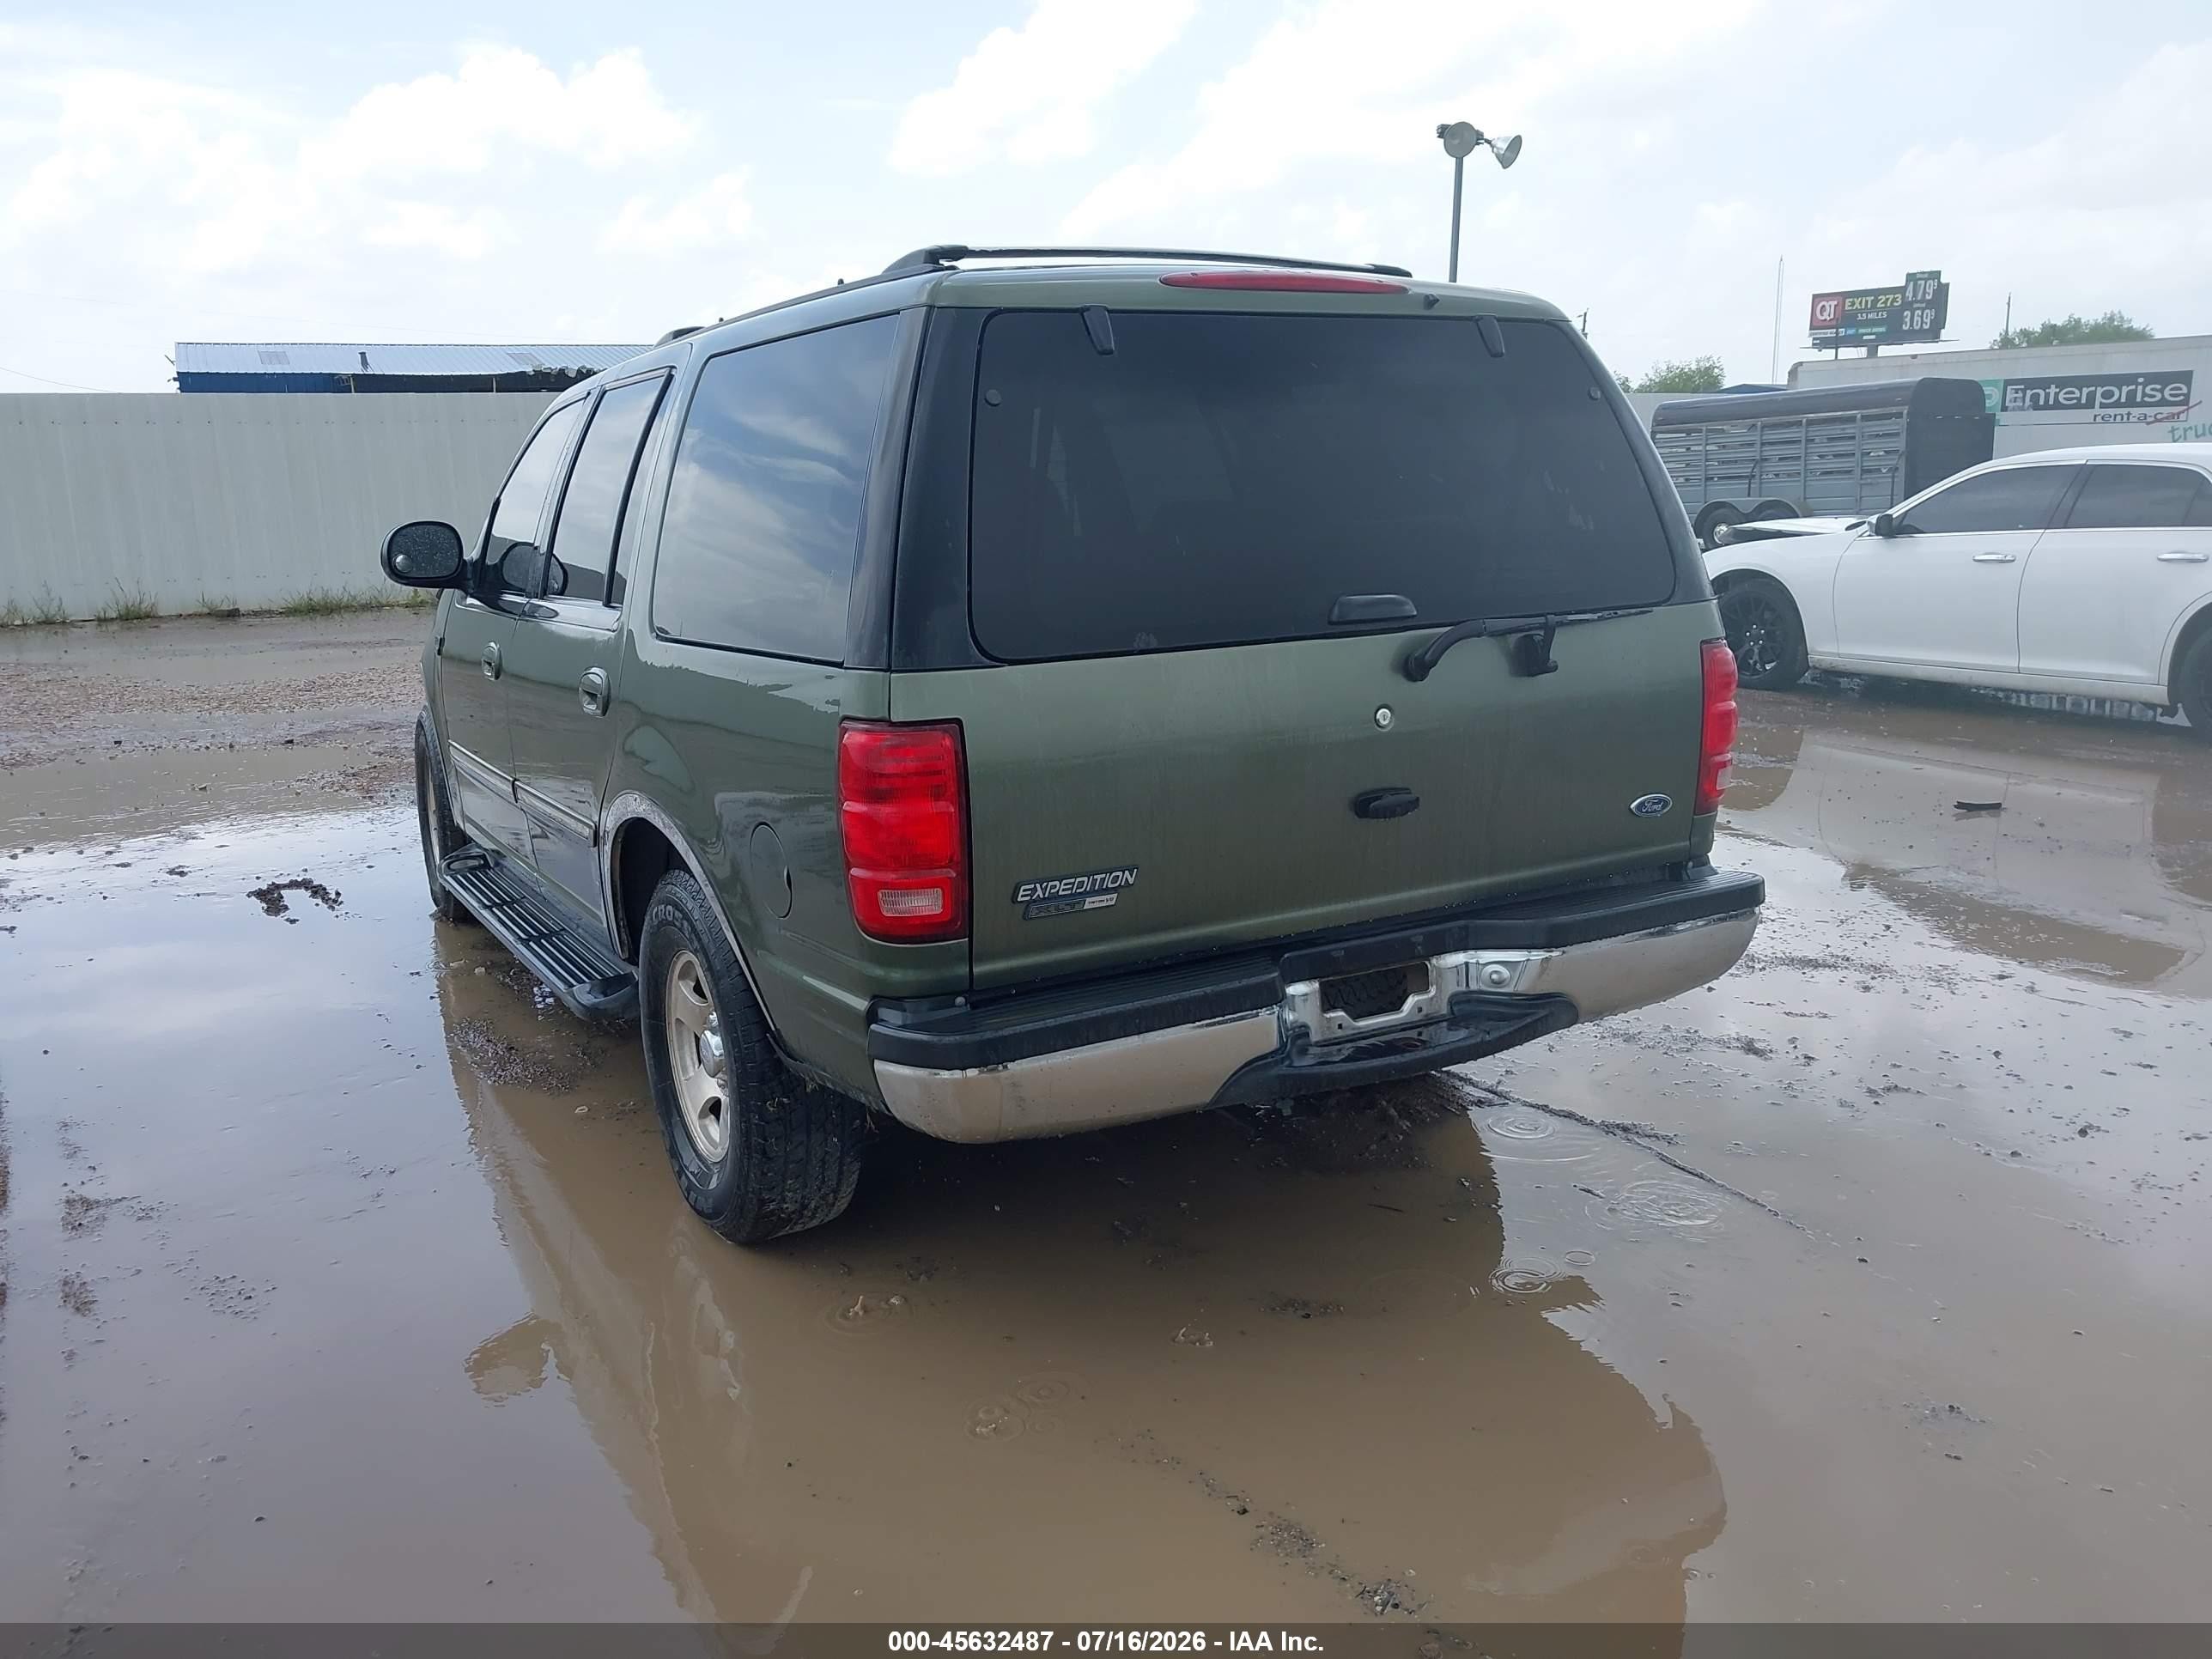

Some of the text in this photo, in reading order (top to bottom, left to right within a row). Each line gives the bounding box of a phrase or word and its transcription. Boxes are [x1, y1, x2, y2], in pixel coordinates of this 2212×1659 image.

[1815, 301, 1838, 321] QT
[1844, 294, 1902, 310] EXIT 273
[1868, 311, 1887, 319] MILES
[1902, 309, 1931, 330] 3.69
[2005, 377, 2188, 410] Enterprise
[2093, 410, 2186, 422] rent-a-car
[1017, 868, 1138, 902] EXPEDITION
